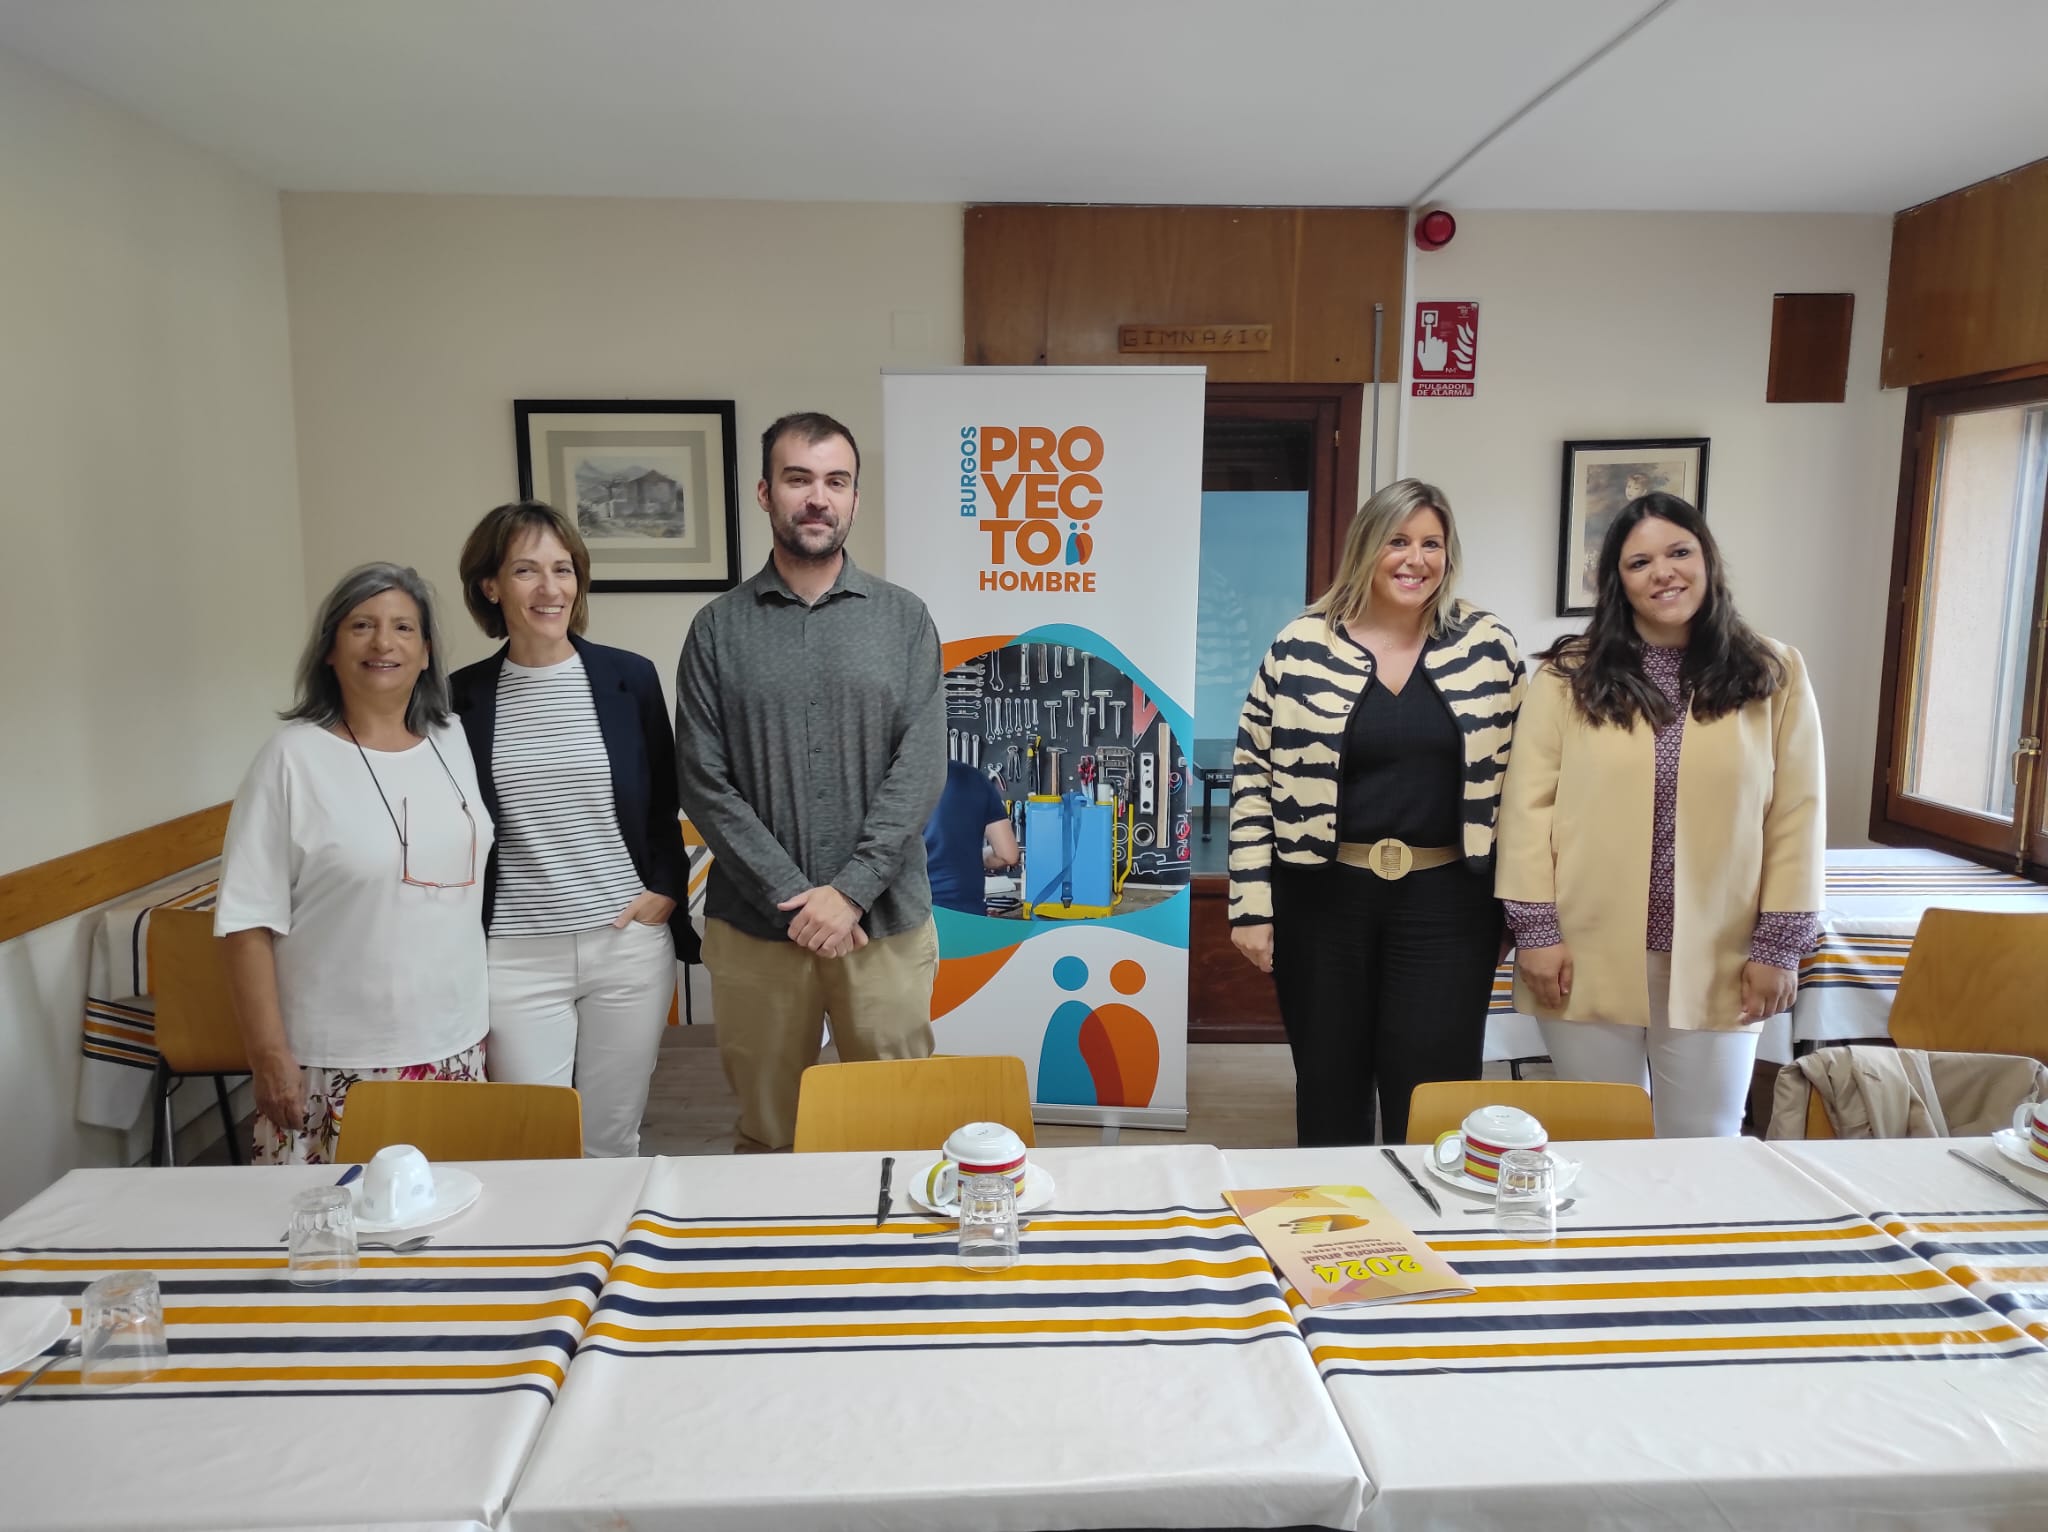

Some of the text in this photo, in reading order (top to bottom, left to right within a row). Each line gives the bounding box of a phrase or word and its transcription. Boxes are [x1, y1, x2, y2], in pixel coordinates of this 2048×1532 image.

[1123, 329, 1268, 347] GIMNASIO
[980, 425, 1104, 473] PRO
[961, 426, 977, 517] BURGOS
[980, 473, 1103, 520] YEC
[979, 519, 1062, 566] TO
[979, 570, 1096, 592] HOMBRE
[1302, 1246, 1407, 1264] memoria anual
[1312, 1254, 1423, 1284] 2024
